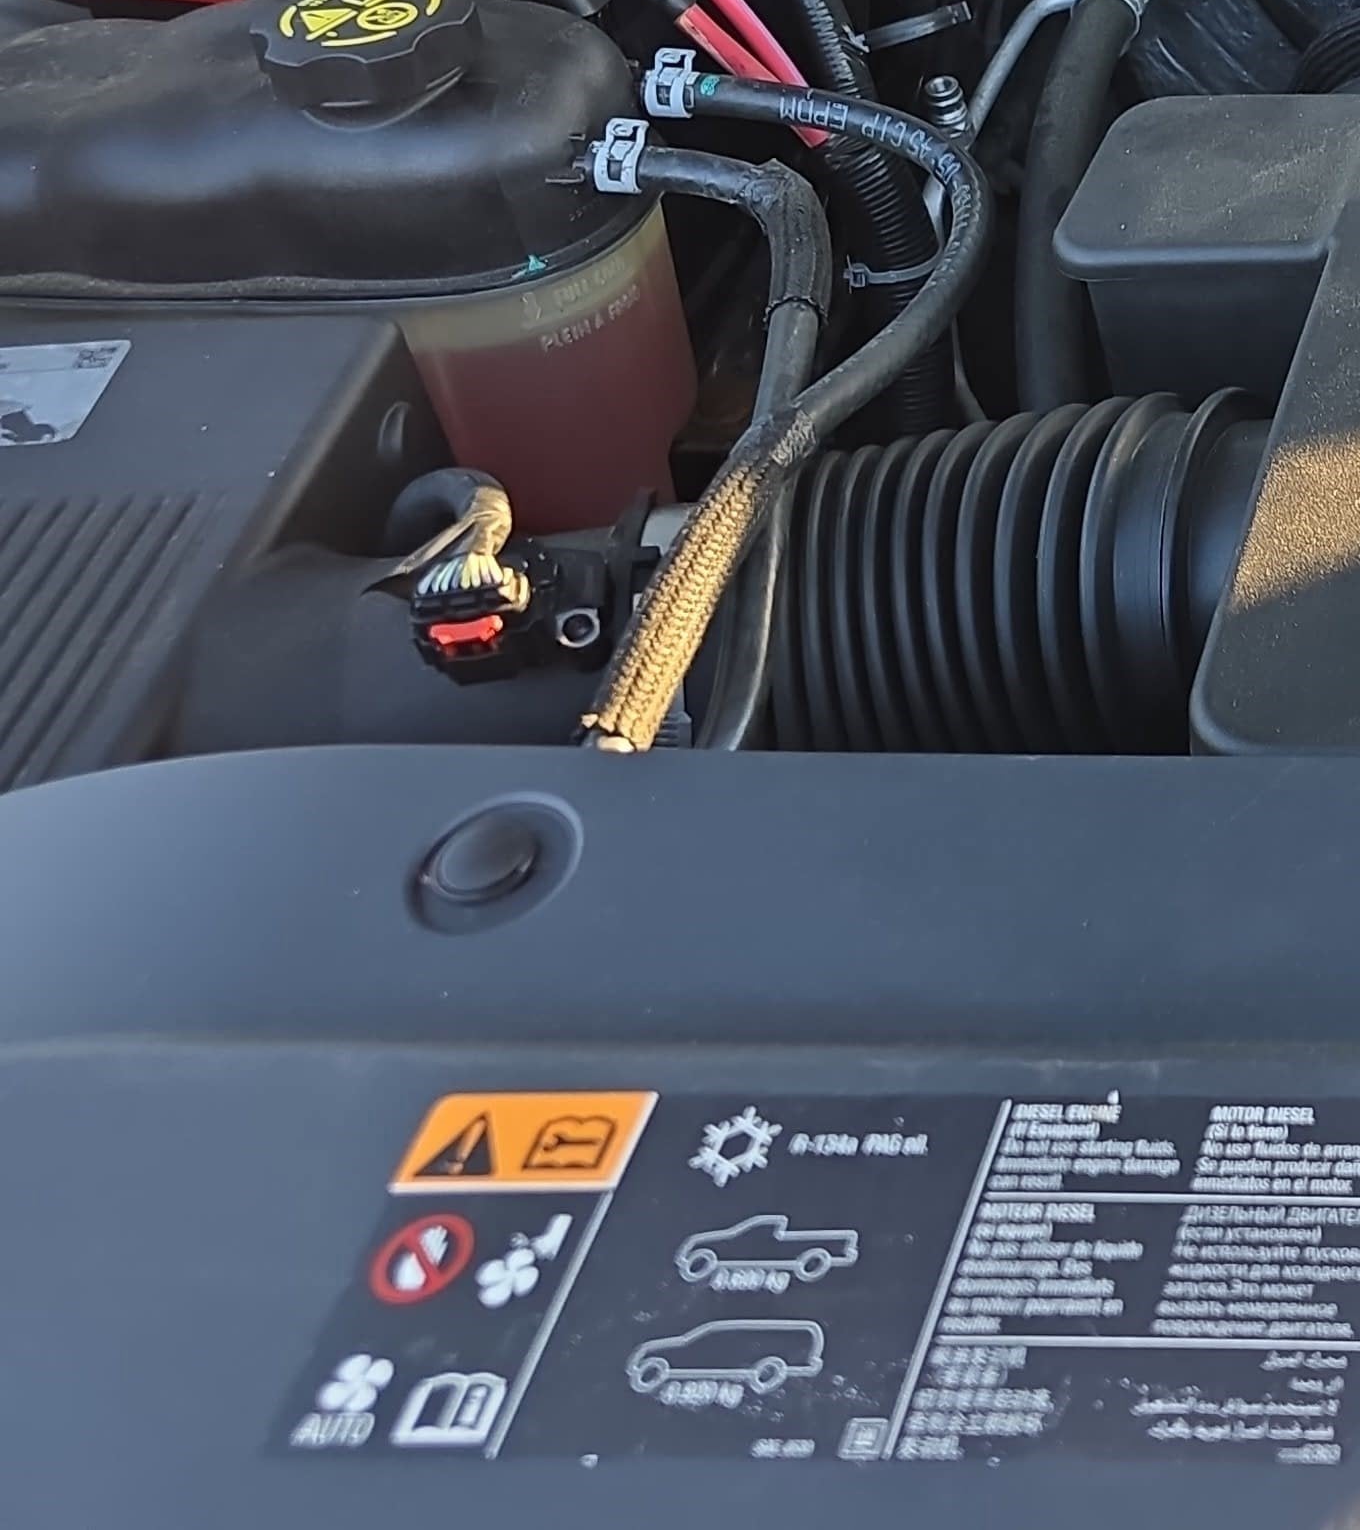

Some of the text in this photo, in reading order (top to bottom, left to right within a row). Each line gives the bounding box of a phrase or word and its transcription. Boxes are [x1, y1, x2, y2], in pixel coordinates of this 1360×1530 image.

[779, 96, 848, 130] EPDM
[1012, 1104, 1122, 1123] DIESEL ENGINE
[1209, 1106, 1315, 1125] MOTOR DIESEL
[1205, 1123, 1229, 1140] (Si
[1247, 1124, 1288, 1141] tiene)
[1201, 1141, 1224, 1157] No
[1225, 1143, 1251, 1157] use
[1253, 1141, 1300, 1158] fluidos
[1303, 1142, 1321, 1157] de
[1196, 1157, 1218, 1173] Se
[1219, 1158, 1271, 1176] pueden
[1272, 1160, 1332, 1177] producir
[1272, 1178, 1291, 1191] en
[1293, 1177, 1309, 1192] el
[1181, 1205, 1285, 1226] ДИЗЕЛЬНЫЙ
[290, 1412, 375, 1447] AUTO
